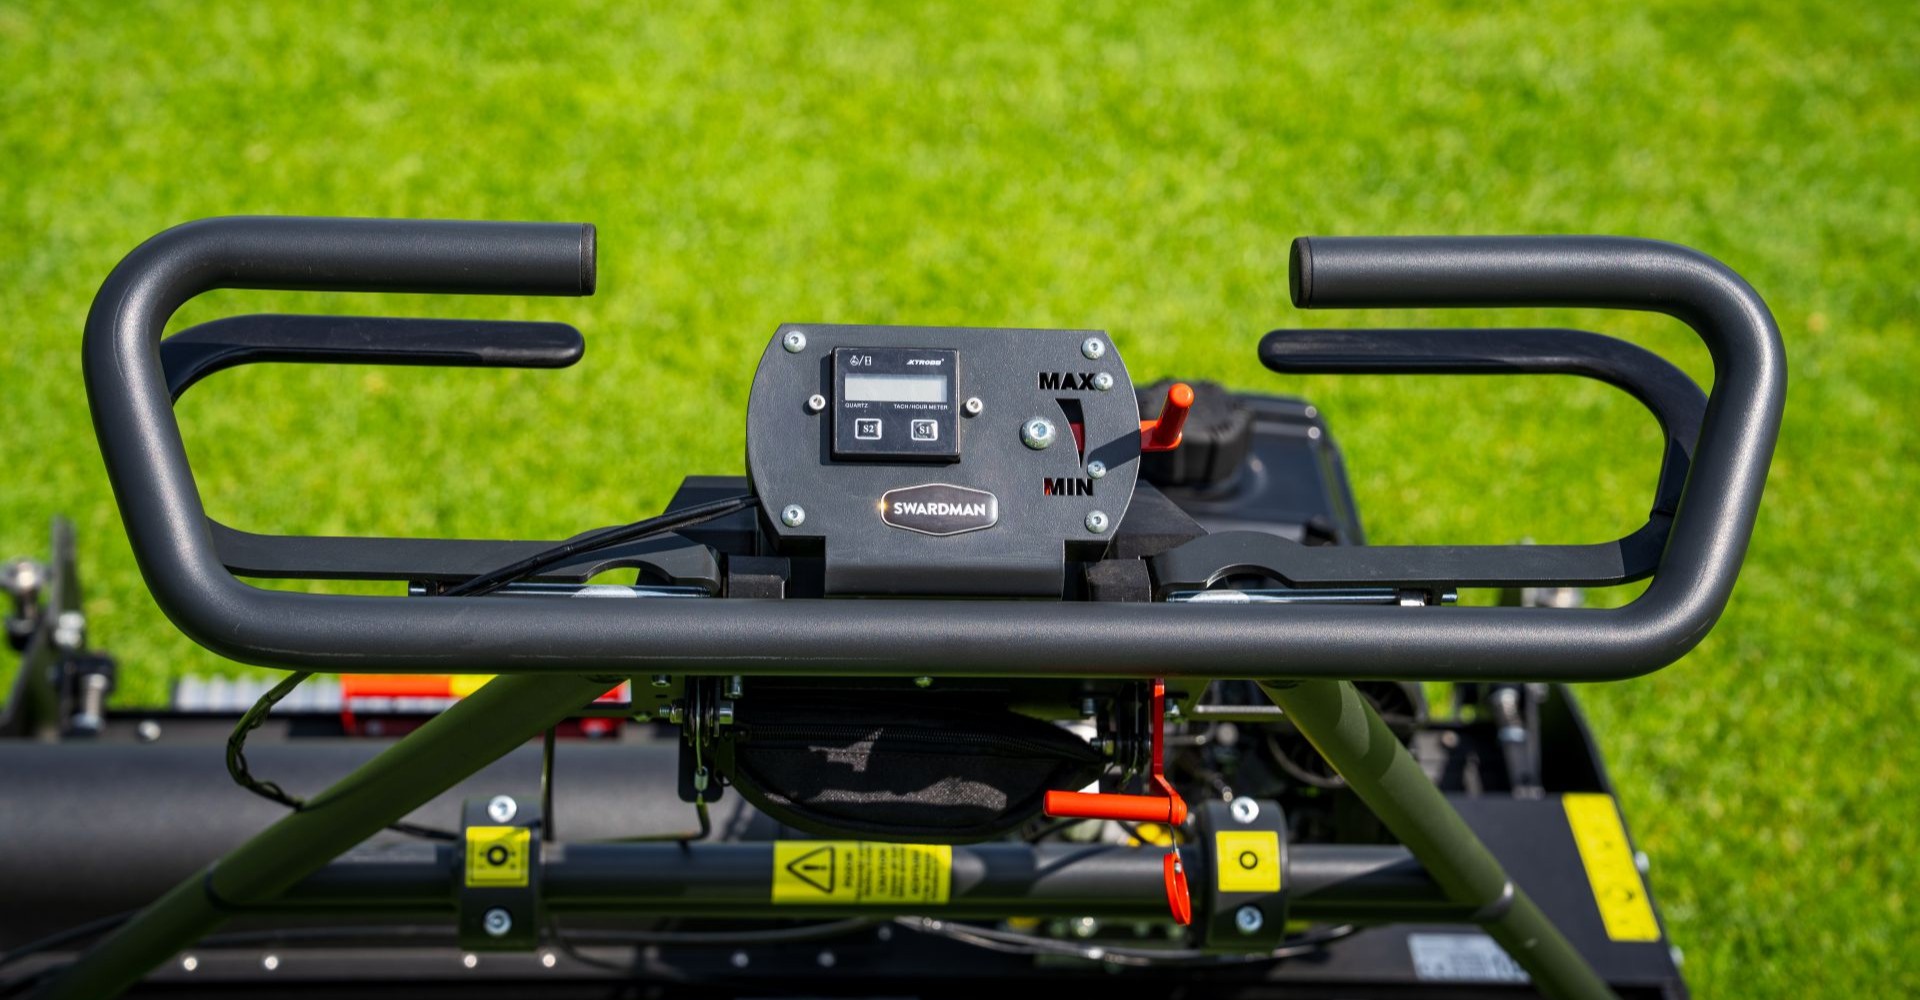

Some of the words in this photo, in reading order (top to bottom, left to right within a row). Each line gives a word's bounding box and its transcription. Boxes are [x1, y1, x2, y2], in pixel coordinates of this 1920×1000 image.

[1038, 372, 1096, 391] MAX
[863, 424, 875, 434] S2
[919, 424, 930, 434] S1
[1043, 477, 1093, 496] MIN
[893, 501, 986, 517] SWARDMAN
